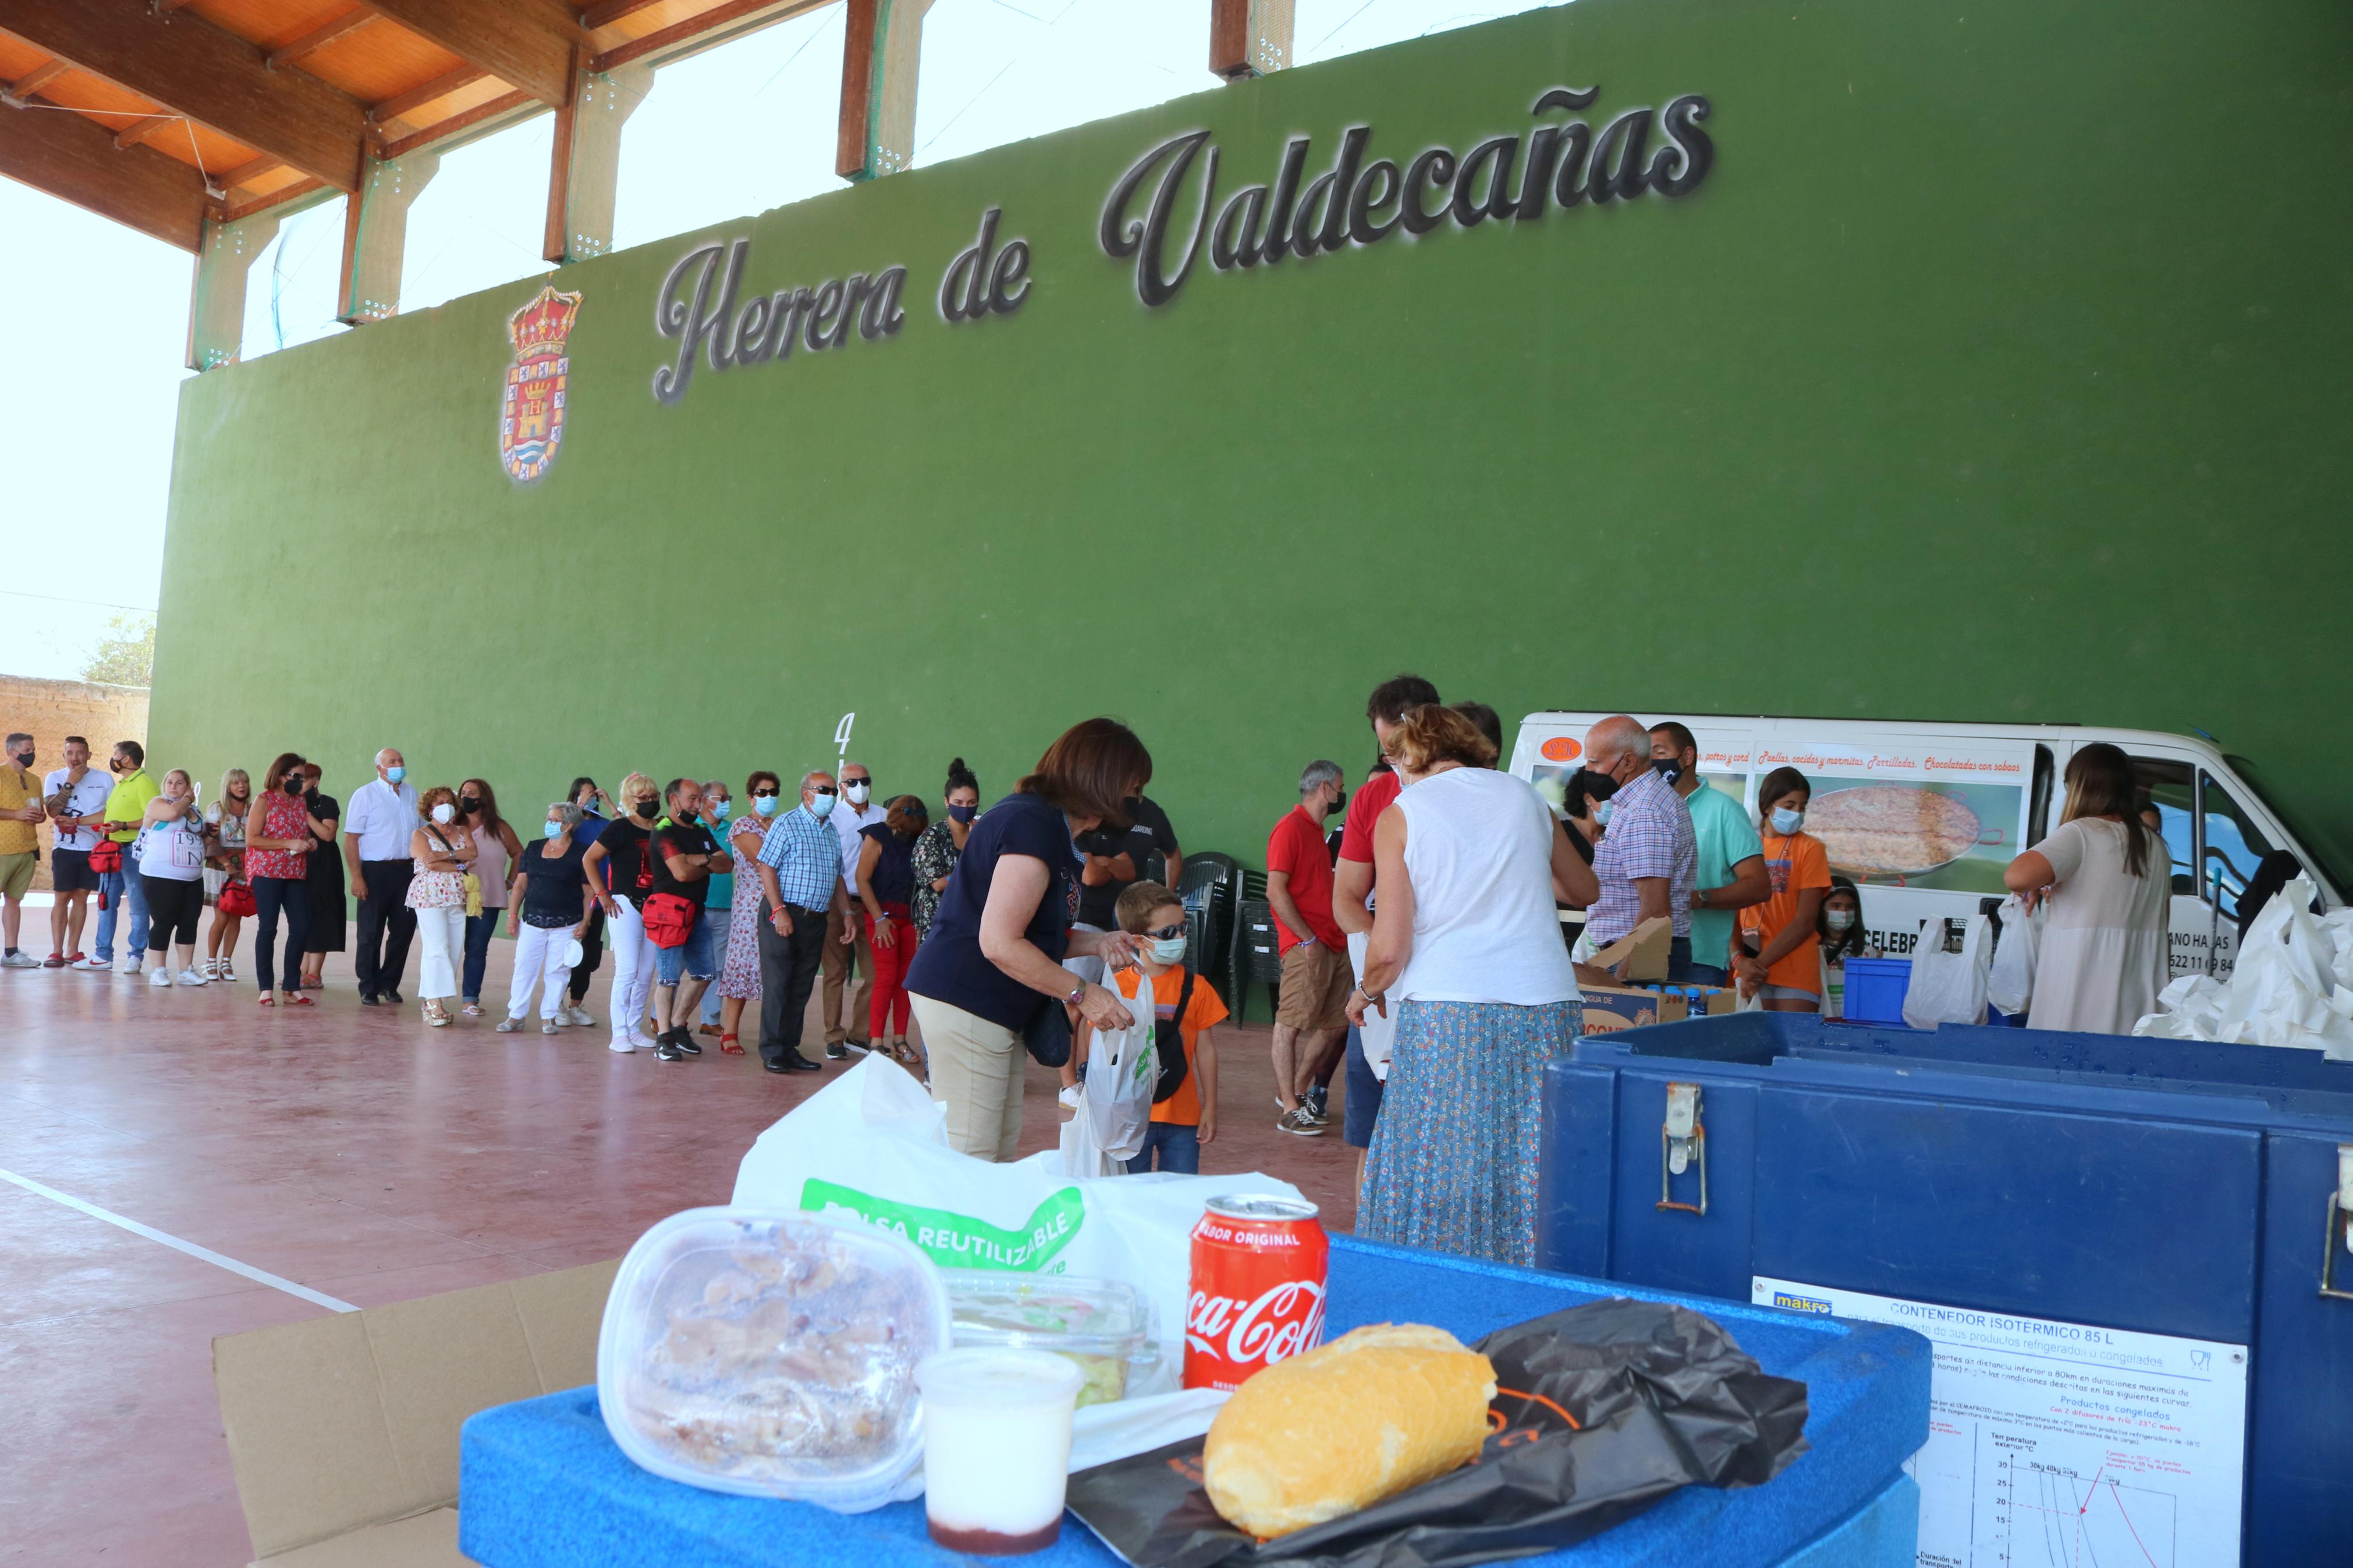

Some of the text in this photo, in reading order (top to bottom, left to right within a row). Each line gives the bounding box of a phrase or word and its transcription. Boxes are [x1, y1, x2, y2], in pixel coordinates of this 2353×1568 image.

[654, 238, 906, 400] Herrera
[1101, 86, 1714, 307] Valdecañas
[834, 713, 855, 754] 4
[1726, 755, 1733, 766] y
[1758, 751, 1790, 765] Paellas,
[1793, 753, 1818, 764] cocidos
[1818, 759, 1825, 769] y
[1867, 755, 1917, 770] Parrilladas.
[1925, 756, 1976, 770] Chocolatadas
[1994, 759, 2020, 772] sobaos
[1864, 930, 1918, 954] CELEBR
[2169, 932, 2228, 949] ANO HAAS
[2170, 955, 2188, 968] 622
[2191, 957, 2201, 969] 11
[2220, 959, 2233, 972] 84
[1585, 995, 1602, 1003] AGUA
[918, 1211, 1070, 1267] REUTILIZABLE
[1235, 1231, 1301, 1246] ORIGINAL
[1777, 1296, 1830, 1313] makro
[1891, 1303, 2114, 1345] CONTENEDOR ISOTÉRMICO 85 L
[2100, 1352, 2163, 1367] congelados
[2002, 1374, 2047, 1385] condiciones
[2103, 1387, 2114, 1396] las
[2117, 1391, 2159, 1402] siguientes
[2015, 1364, 2045, 1375] inferior
[2055, 1371, 2077, 1380] 80km
[2092, 1377, 2136, 1389] duraciones
[2178, 1388, 2188, 1396] de
[2061, 1395, 2170, 1420] Productos congelados
[2072, 1410, 2103, 1420] difusores
[2030, 1462, 2045, 1471] 30kg
[2046, 1465, 2061, 1474] 40kg
[1921, 1551, 1950, 1563] Duración
